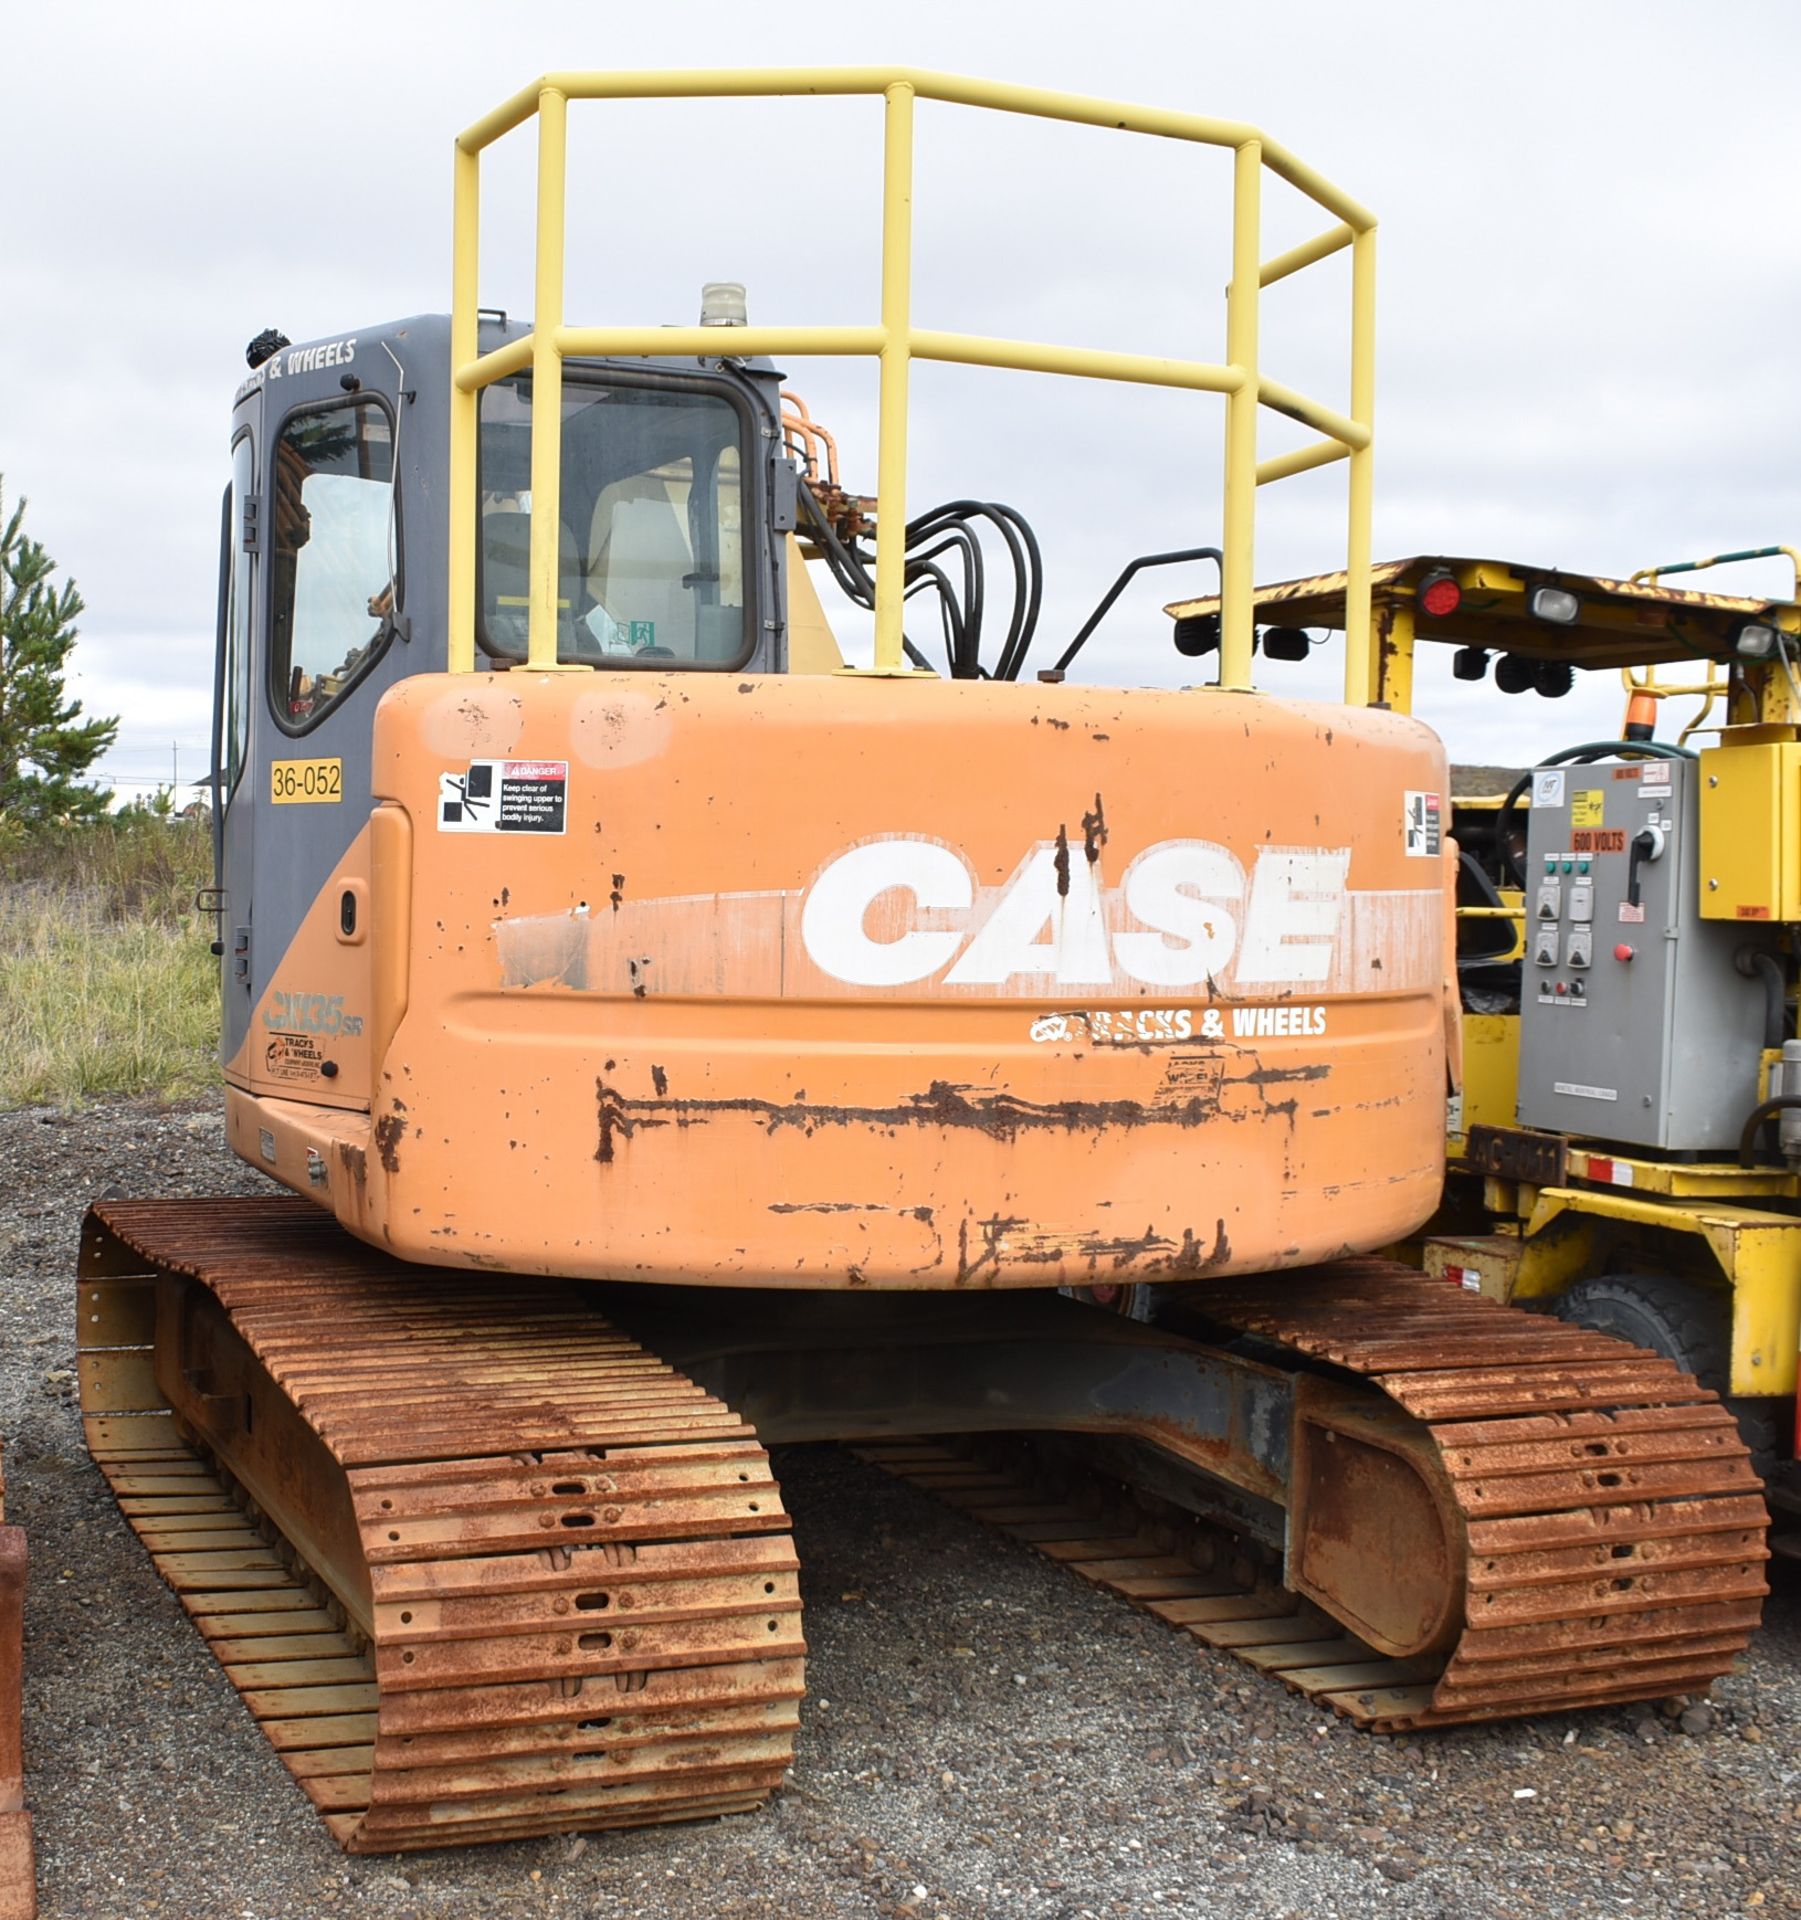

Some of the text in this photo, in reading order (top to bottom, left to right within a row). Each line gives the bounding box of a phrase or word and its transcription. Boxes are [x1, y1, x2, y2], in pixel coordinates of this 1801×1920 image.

[269, 339, 357, 379] & WHEELS
[520, 767, 557, 777] DANGER
[273, 765, 340, 796] 36-052
[503, 783, 547, 793] Keep clear of
[503, 794, 563, 804] swinging upper to
[502, 804, 553, 812] prevent serious
[502, 812, 521, 822] bodily
[1573, 831, 1624, 852] 600 VOLTS
[802, 834, 1350, 985] CASE
[1200, 1008, 1225, 1038] &
[1232, 1006, 1326, 1037] WHEELS
